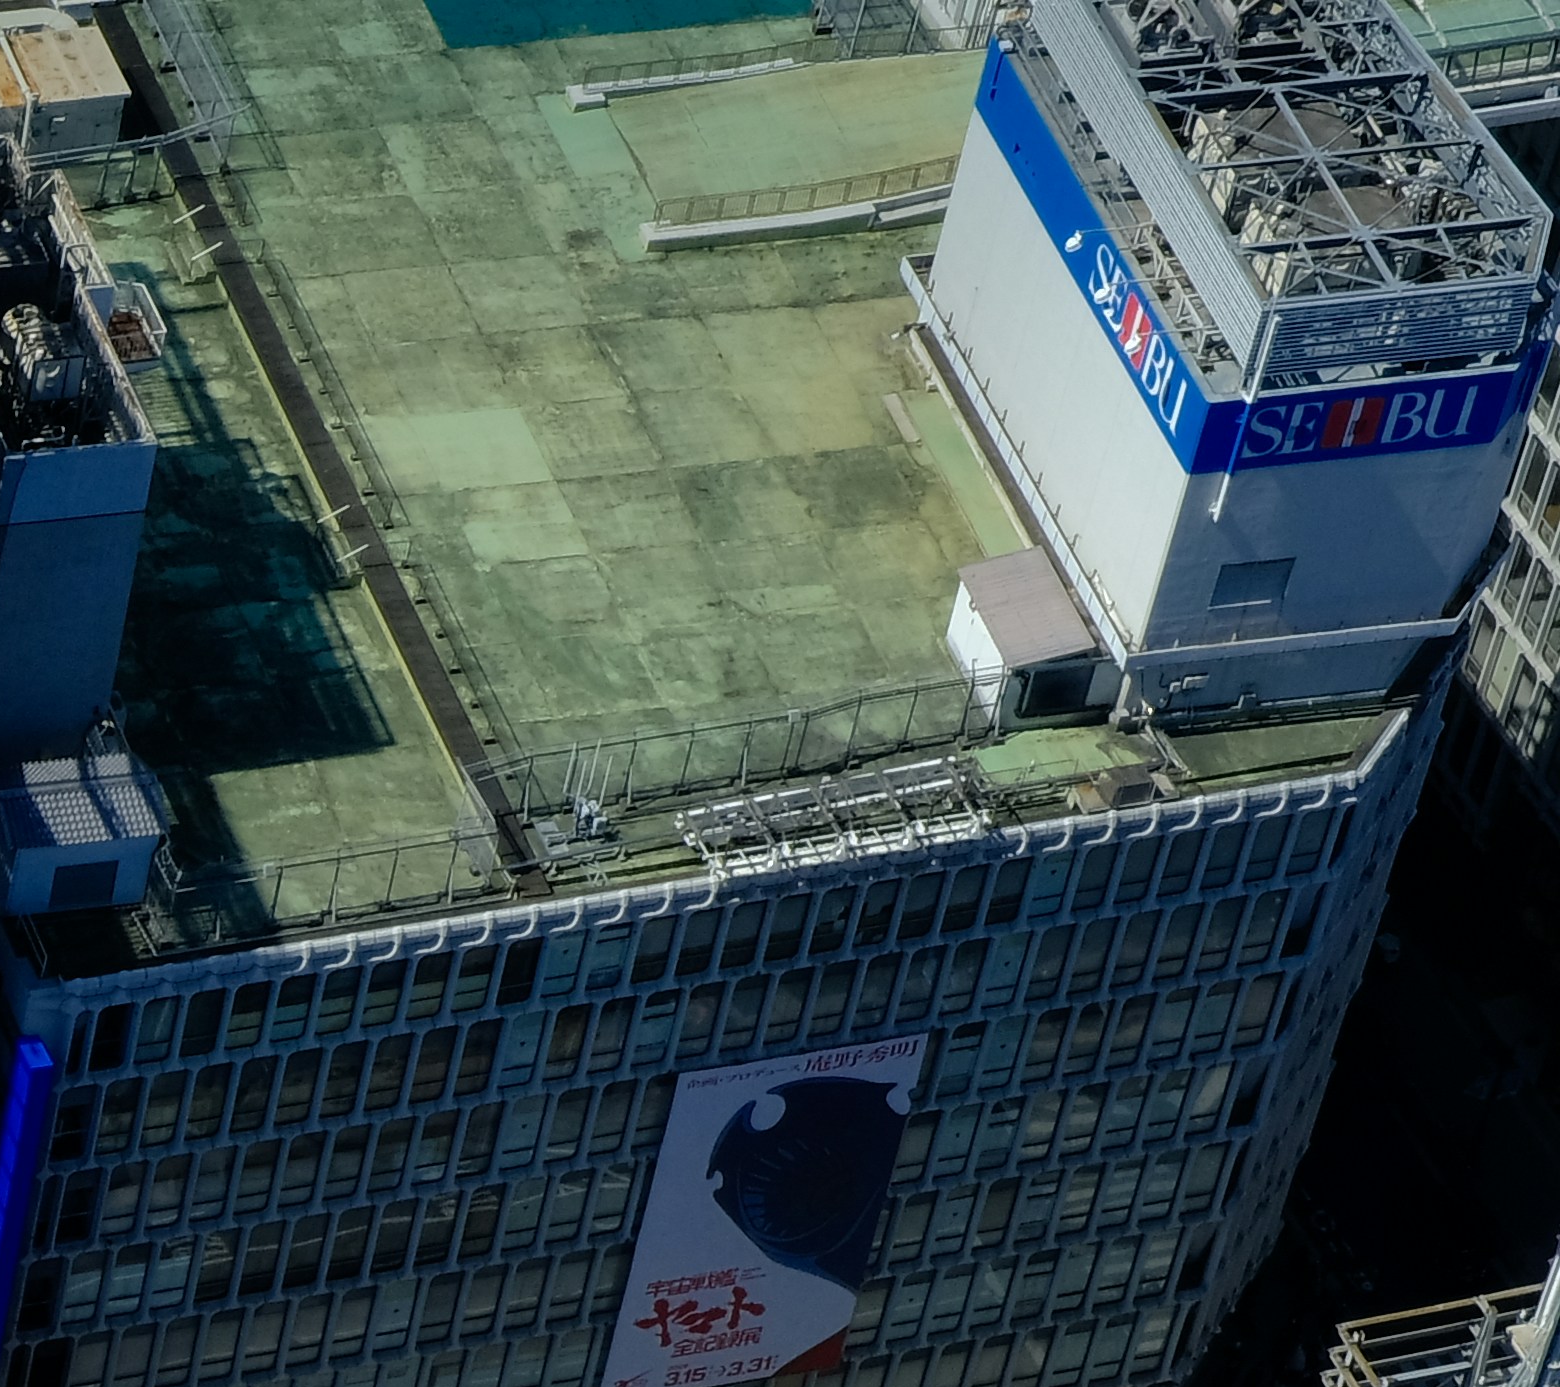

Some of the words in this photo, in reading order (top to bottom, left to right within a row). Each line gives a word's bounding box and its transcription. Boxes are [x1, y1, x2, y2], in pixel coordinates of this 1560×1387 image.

[1242, 383, 1482, 460] SEIBU
[634, 1286, 766, 1348] ヤマト
[664, 1366, 708, 1387] 3.15
[727, 1355, 773, 1377] 3.31
